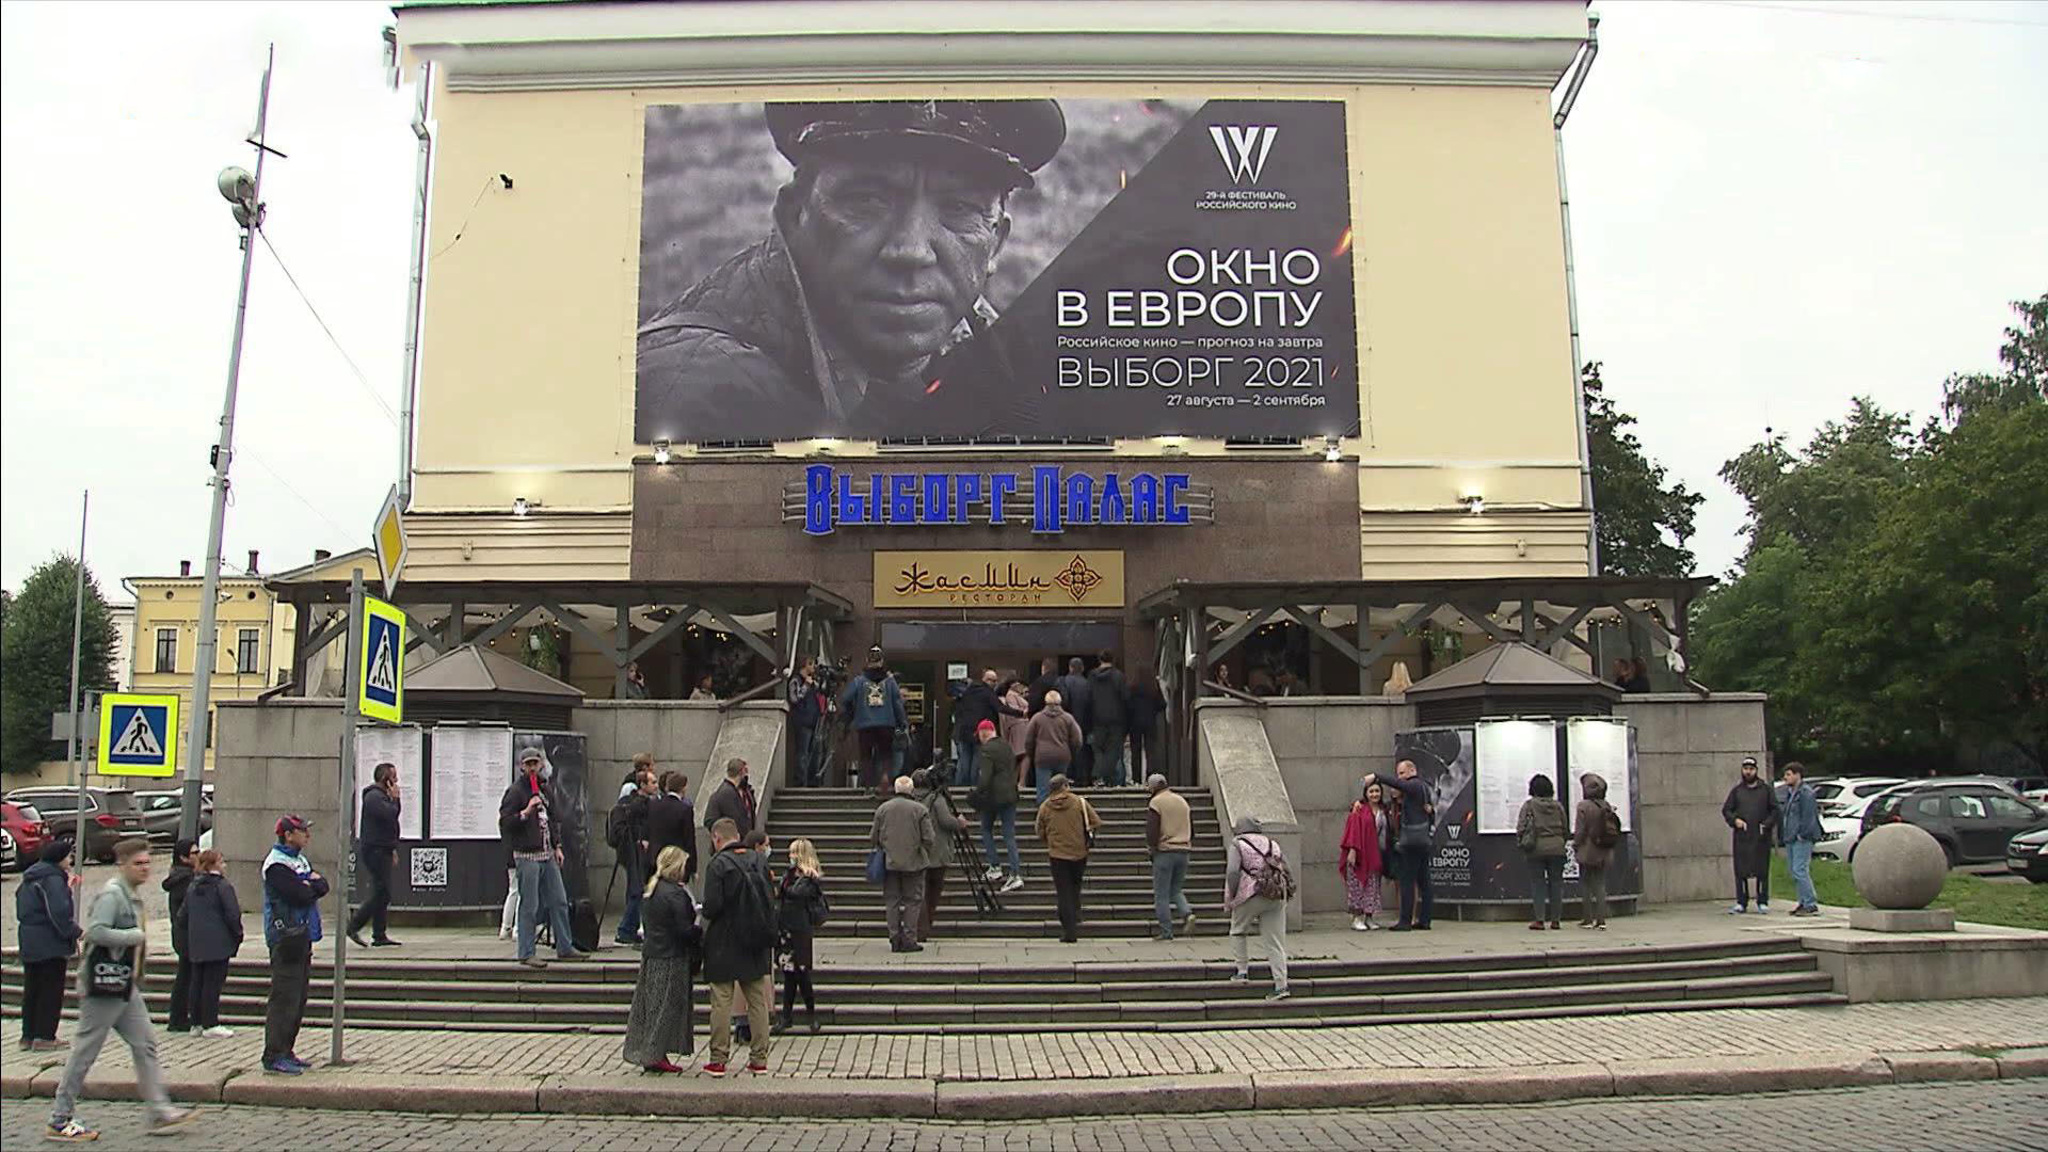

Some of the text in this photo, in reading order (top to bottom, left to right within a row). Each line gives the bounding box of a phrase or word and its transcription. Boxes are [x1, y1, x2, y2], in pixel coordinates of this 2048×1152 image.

[1227, 191, 1286, 200] ФЕСТИВАЛЬ
[1196, 200, 1297, 210] РОССИЙСКОГО КИНО
[1166, 248, 1320, 285] ОКНО
[1057, 291, 1323, 327] В ЕВРОПУ
[1057, 336, 1140, 348] Российское
[1143, 338, 1178, 348] кино
[1198, 338, 1254, 351] прогноз
[1258, 338, 1274, 348] на
[1277, 338, 1323, 351] завтра
[1058, 357, 1324, 387] ВЫБОРГ 2021
[1167, 395, 1182, 406] 27
[1185, 396, 1234, 409] августа
[1253, 395, 1262, 406] 2
[1264, 394, 1326, 408] сентября
[894, 561, 1050, 594] Жасмин
[950, 593, 1041, 603] РЕСТОРАН
